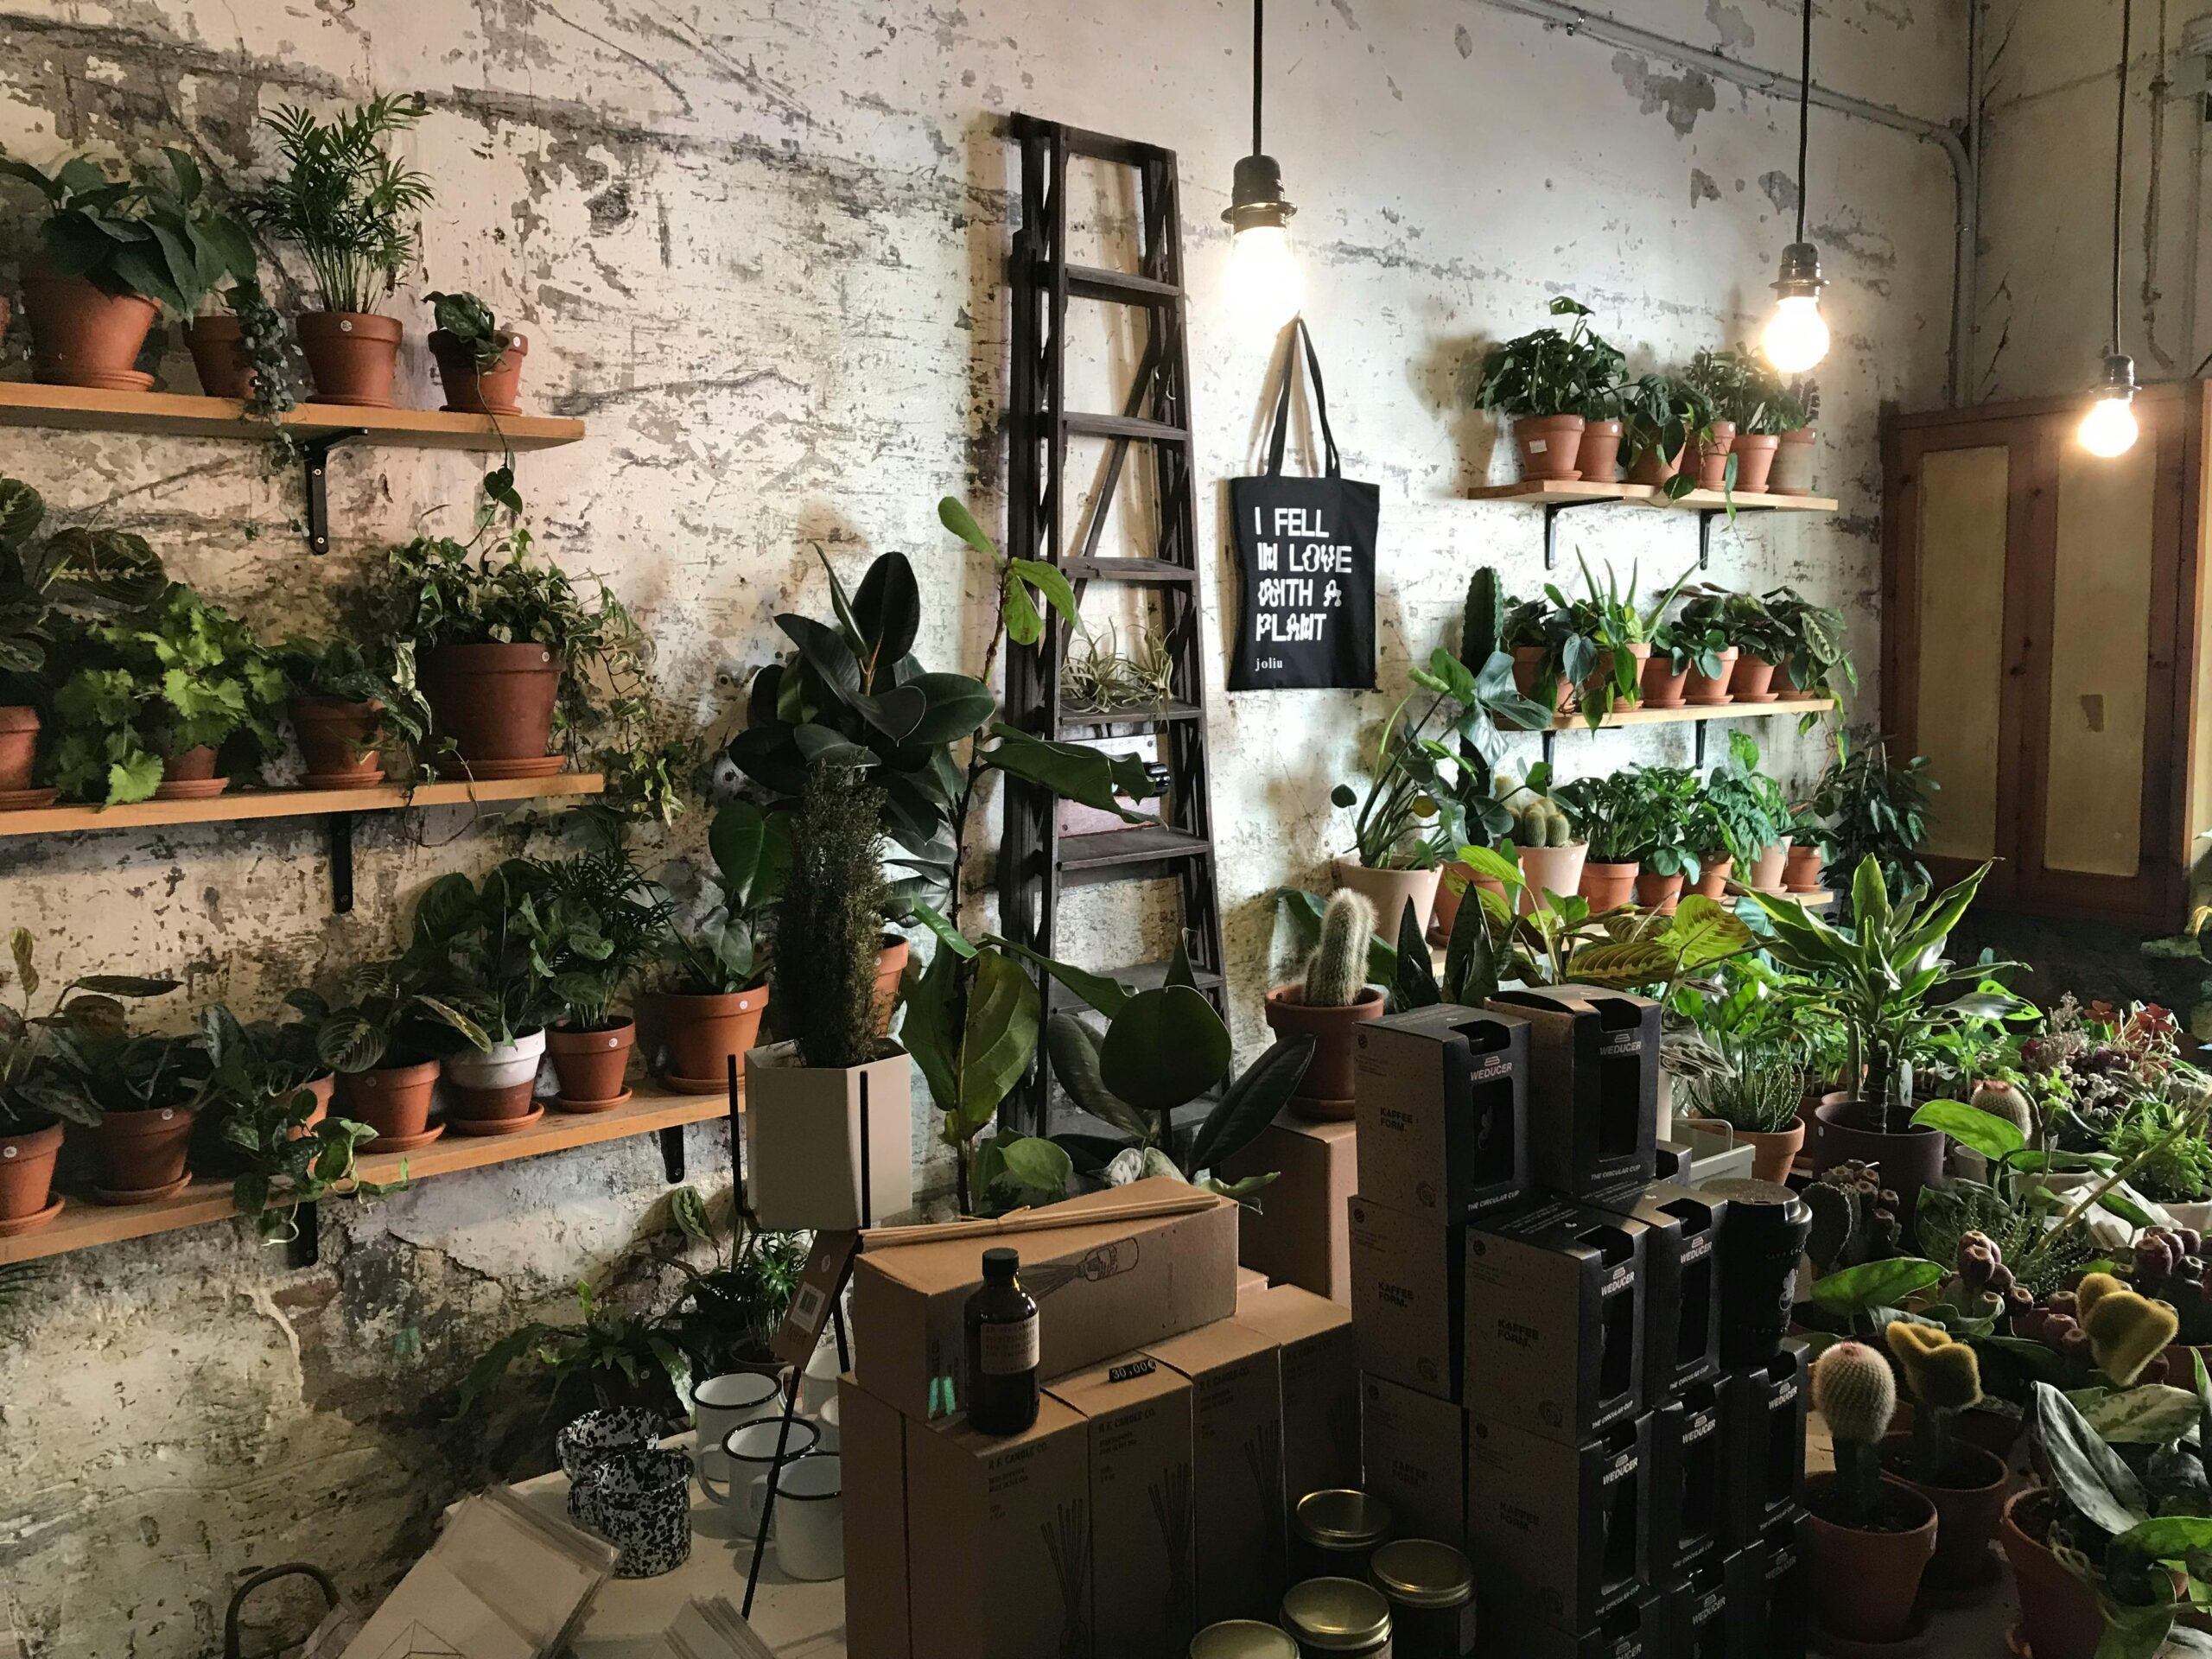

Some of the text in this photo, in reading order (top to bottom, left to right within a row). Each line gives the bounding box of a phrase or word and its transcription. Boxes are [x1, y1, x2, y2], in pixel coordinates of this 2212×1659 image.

[1255, 506, 1330, 538] I FELL
[1256, 542, 1352, 574] IN LOVE
[1257, 578, 1342, 607] WITH A
[1255, 613, 1326, 642] PLANT
[1255, 657, 1283, 672] joliu
[1599, 1040, 1642, 1056] WEDUCER
[1470, 1062, 1513, 1082] WEDUCER
[1379, 1107, 1414, 1125] KAFFEE
[1591, 1163, 1642, 1181] THE CIRCULAR CUP
[1468, 1189, 1521, 1212] THE CIRCULAR CUP
[1680, 1241, 1713, 1264] WEDUCER
[1377, 1281, 1414, 1300] KAFFEE
[1600, 1270, 1636, 1297] WEDUCER
[1378, 1291, 1408, 1308] FORM.
[1497, 1319, 1539, 1341] KAFFEE
[1681, 1418, 1716, 1444] WEDUCER
[1603, 1456, 1638, 1486] WEDUCER
